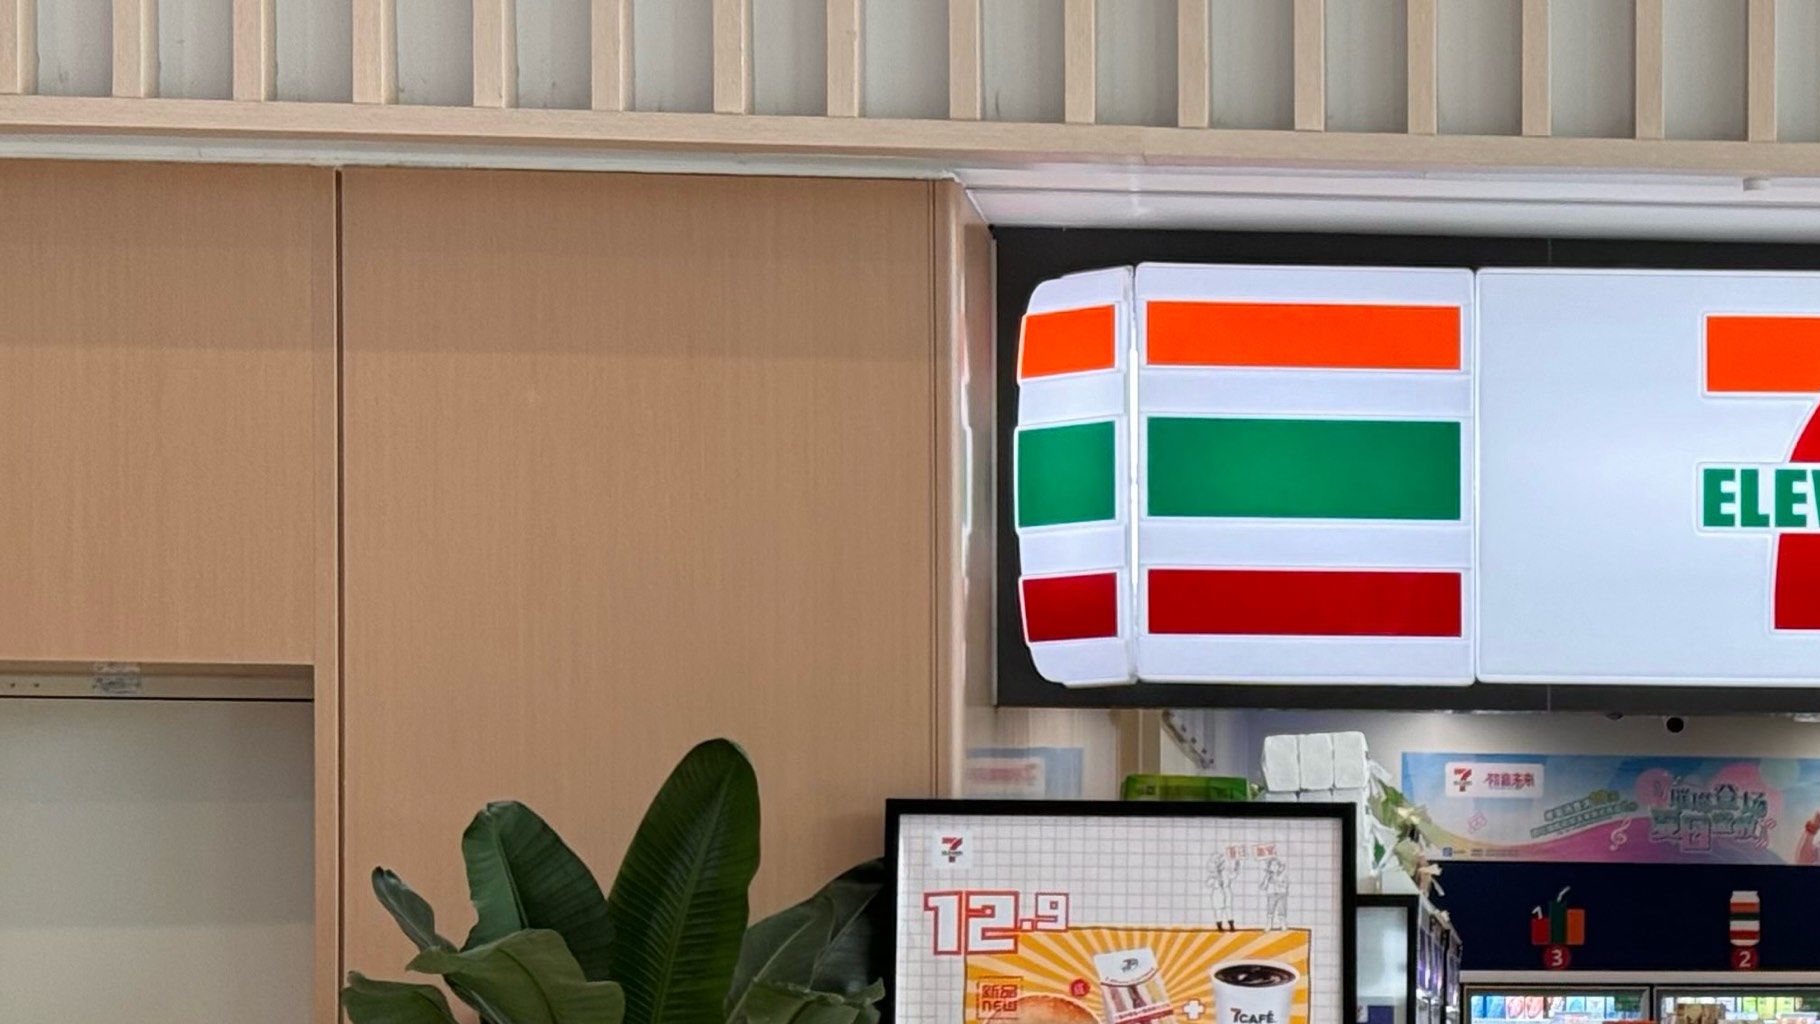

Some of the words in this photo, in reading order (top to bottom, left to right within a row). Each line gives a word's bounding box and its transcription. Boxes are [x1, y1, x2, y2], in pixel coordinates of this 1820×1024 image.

[924, 891, 1069, 954] 12.9
[1551, 949, 1563, 967] 3
[1739, 951, 1751, 968] 2
[981, 984, 1018, 999] 新品
